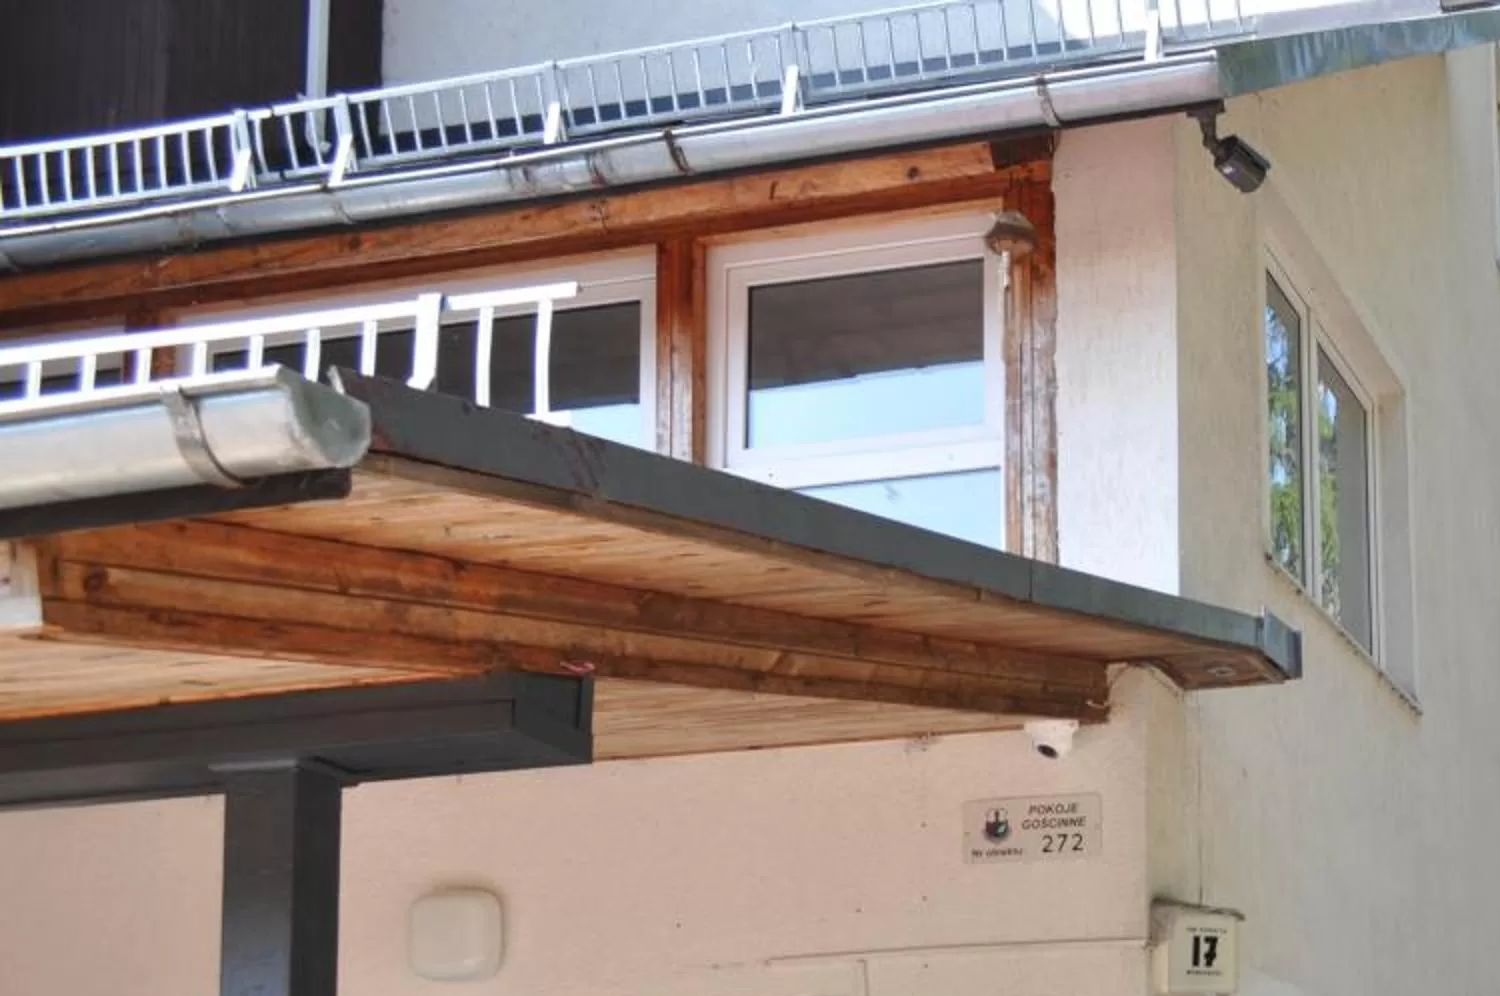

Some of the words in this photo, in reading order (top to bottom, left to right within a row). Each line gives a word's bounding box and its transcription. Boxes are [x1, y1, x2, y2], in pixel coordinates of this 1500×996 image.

[1028, 803, 1078, 815] POKOJE
[1021, 816, 1086, 830] GOŚCINNE
[1041, 833, 1083, 853] 272
[1192, 935, 1218, 967] 17
